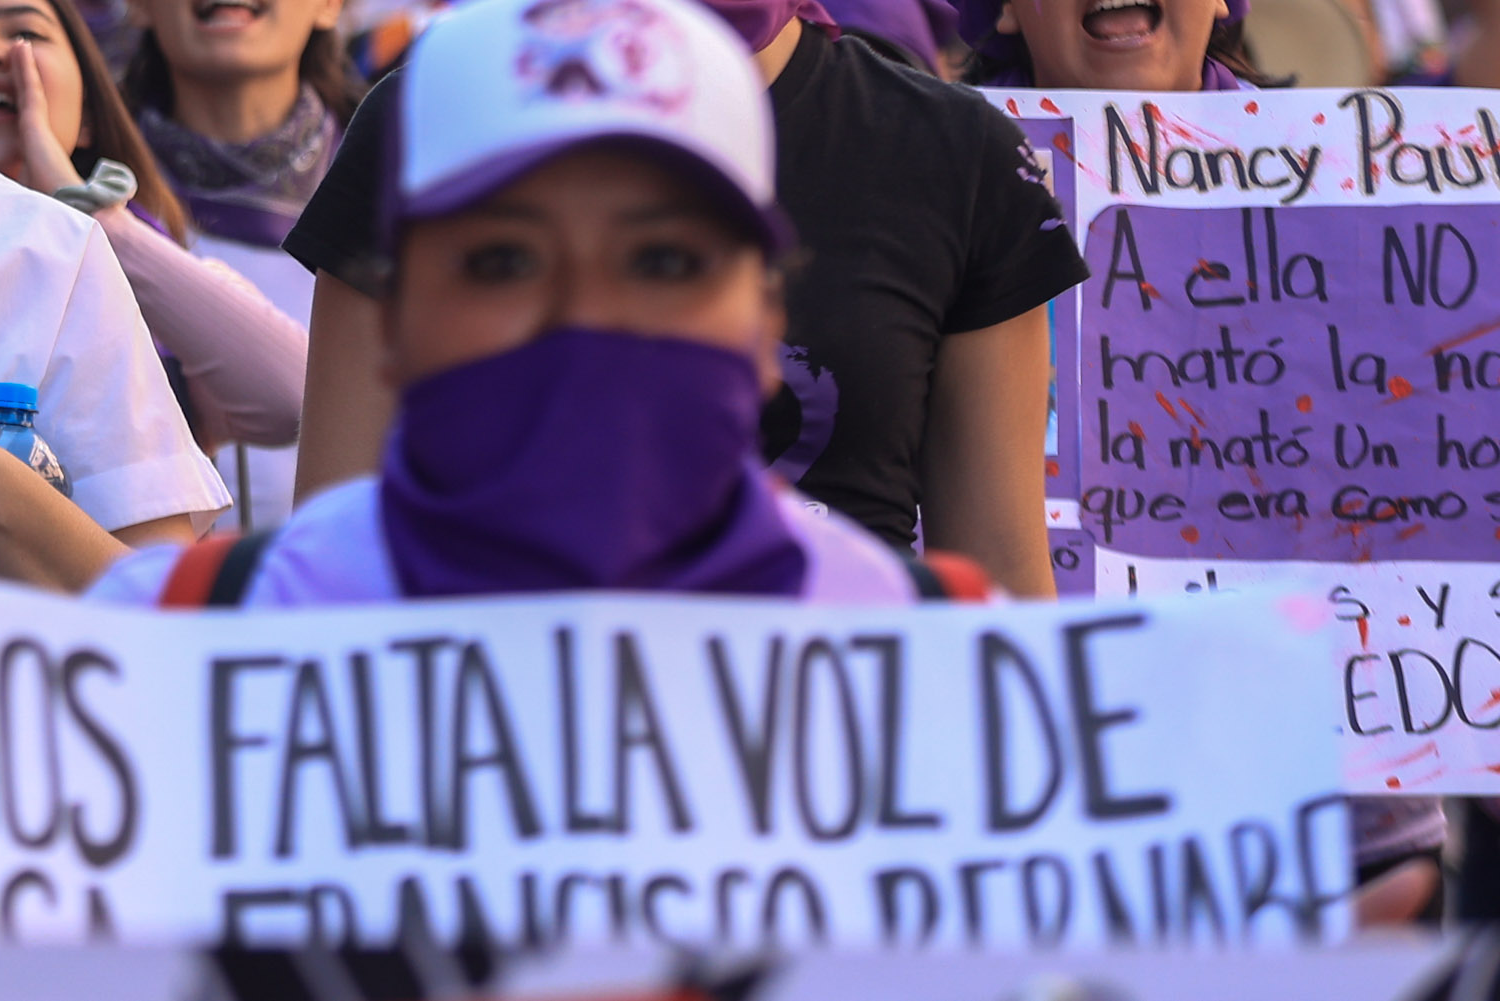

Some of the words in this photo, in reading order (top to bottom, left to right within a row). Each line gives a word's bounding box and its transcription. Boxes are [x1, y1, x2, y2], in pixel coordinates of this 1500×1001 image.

[1104, 100, 1320, 204] Nancy
[1102, 207, 1152, 311] A
[1184, 206, 1329, 308] ella
[1383, 221, 1478, 310] NO
[1100, 324, 1285, 389] mató
[1326, 323, 1387, 395] la
[1098, 397, 1147, 471] la
[1169, 408, 1314, 471] mató
[1082, 485, 1186, 544] que
[1217, 488, 1309, 522] era
[206, 634, 544, 861] FALTA
[550, 624, 694, 838] LA
[706, 630, 947, 843] VOZ
[976, 611, 1173, 834] DE
